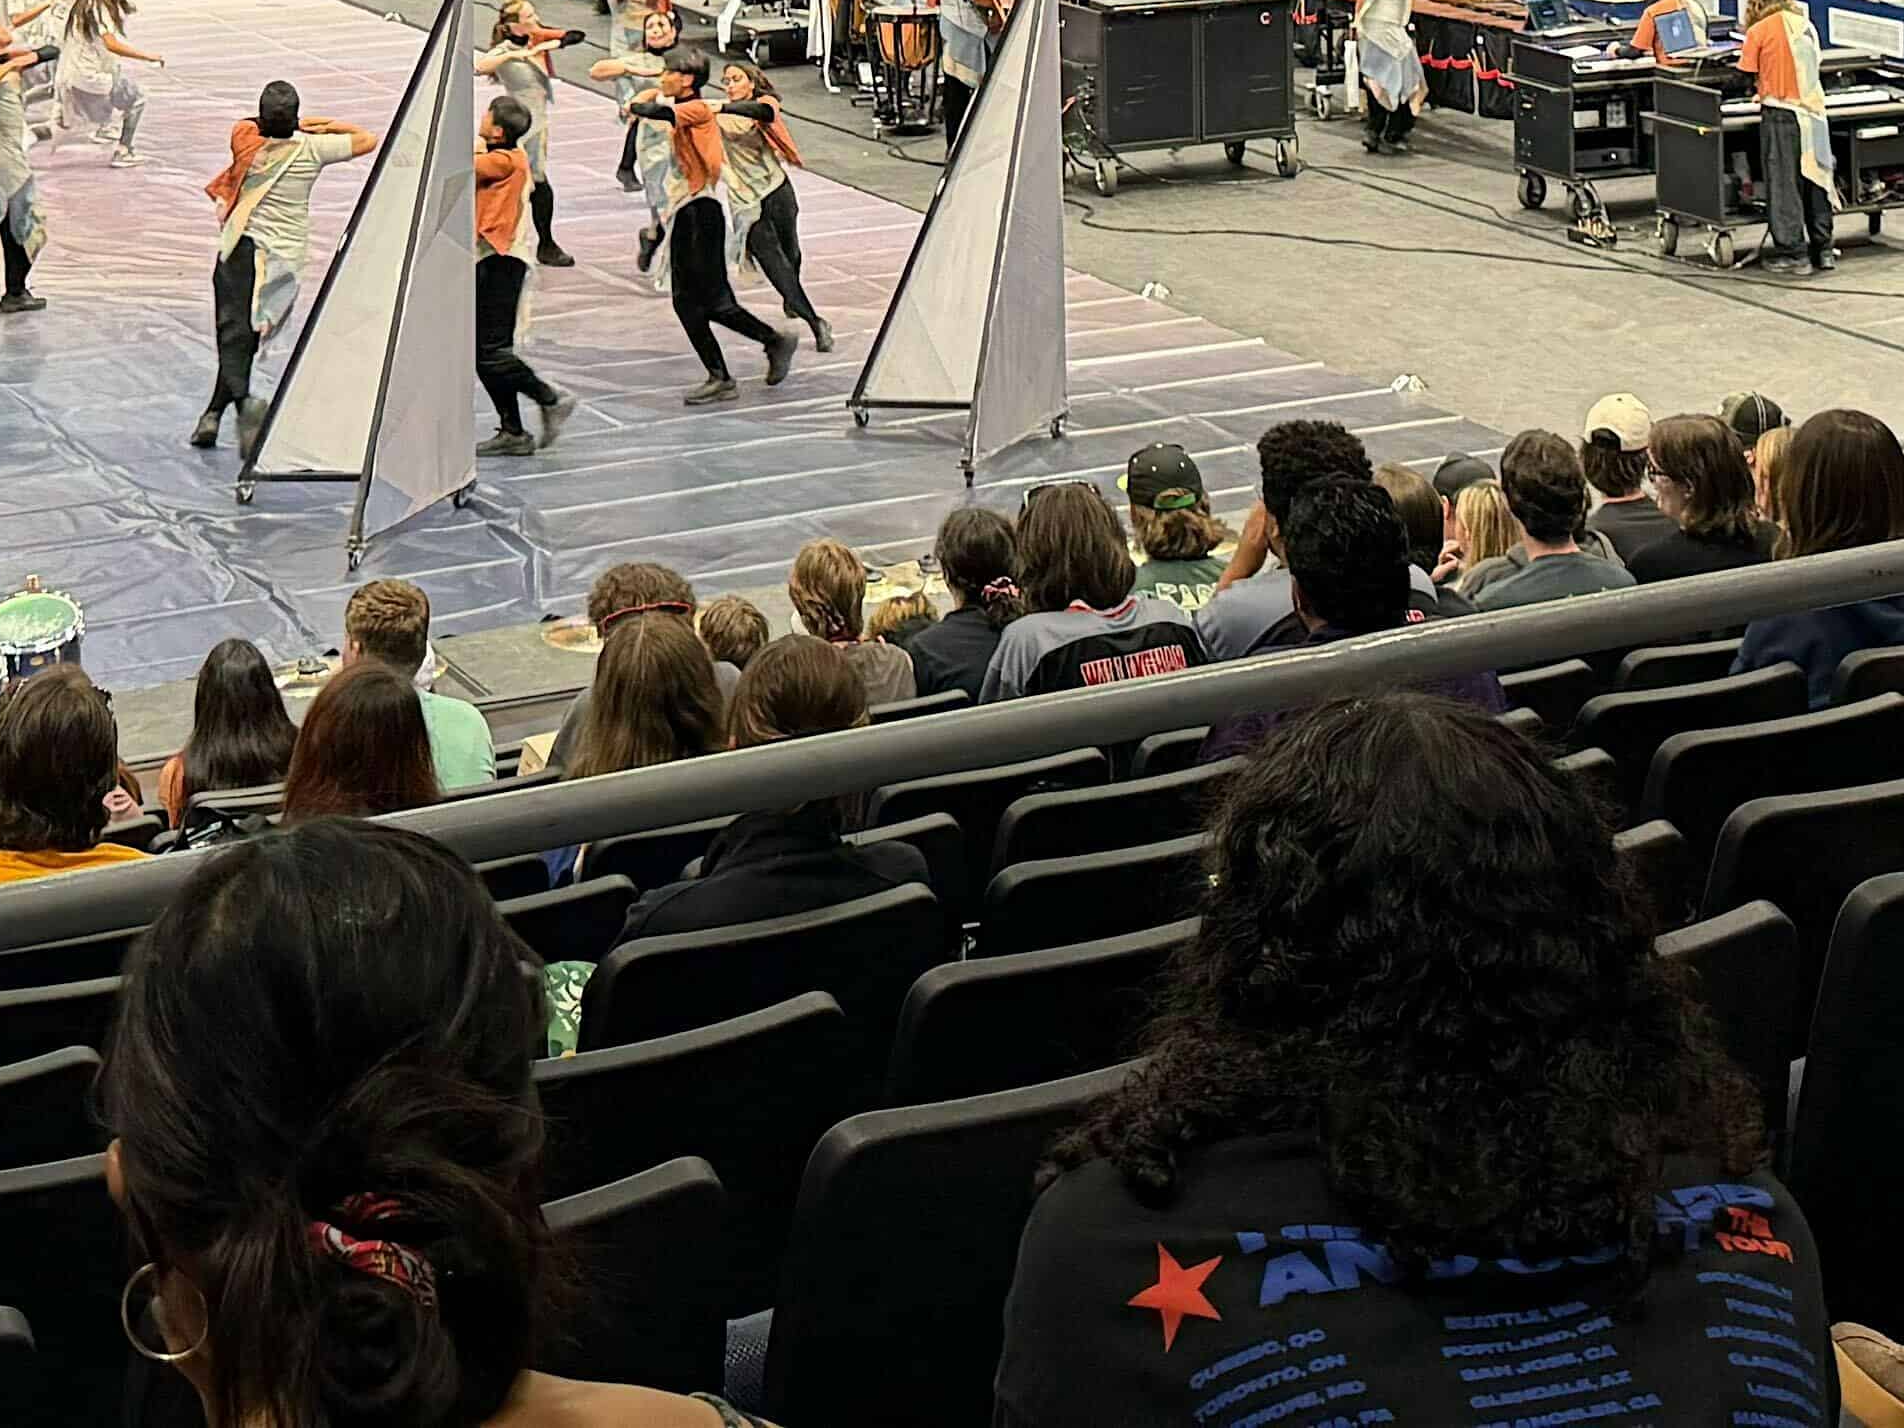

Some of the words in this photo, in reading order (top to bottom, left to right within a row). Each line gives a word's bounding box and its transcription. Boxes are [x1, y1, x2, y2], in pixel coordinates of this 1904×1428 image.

[1713, 1231, 1794, 1265] TOUR
[1459, 1364, 1514, 1384] SAN
[1582, 1343, 1618, 1361] CA
